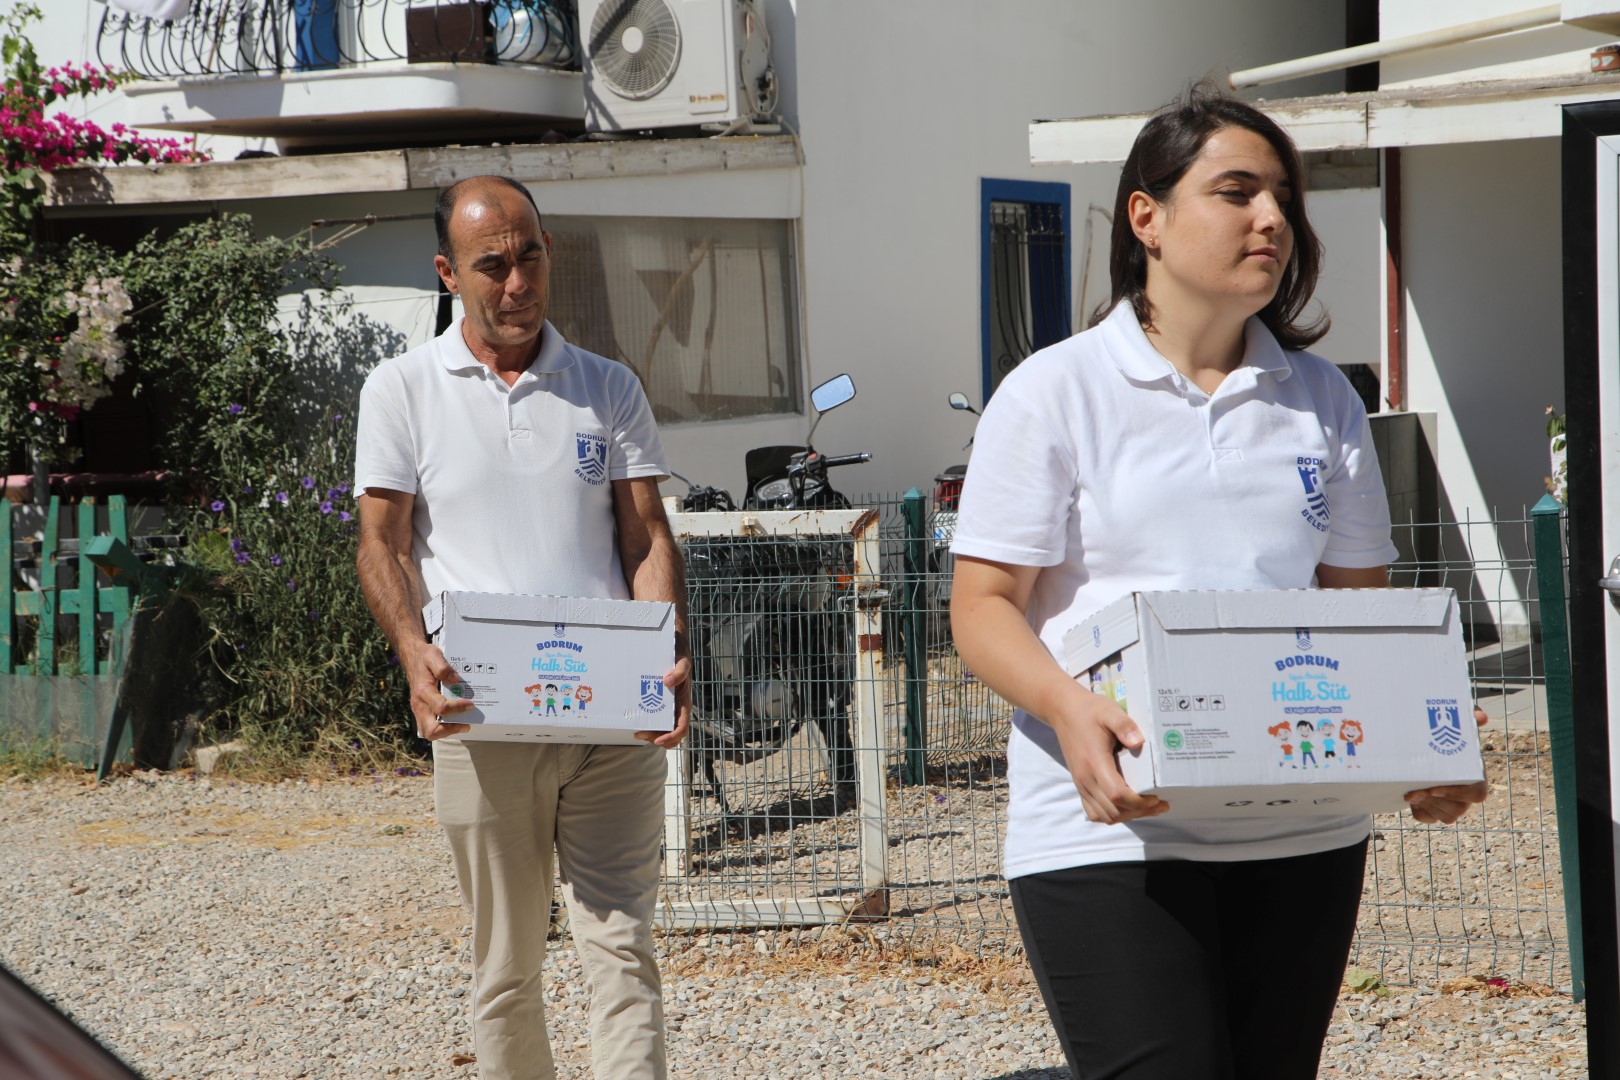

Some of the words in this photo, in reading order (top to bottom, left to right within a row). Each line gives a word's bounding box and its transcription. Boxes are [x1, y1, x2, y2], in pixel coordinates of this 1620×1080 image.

[536, 640, 583, 653] BODRUM
[531, 657, 563, 671] Halk
[563, 658, 588, 673] Süt
[1274, 654, 1339, 671] BODRUM
[1271, 681, 1316, 702] Halk
[1316, 680, 1351, 701] Süt
